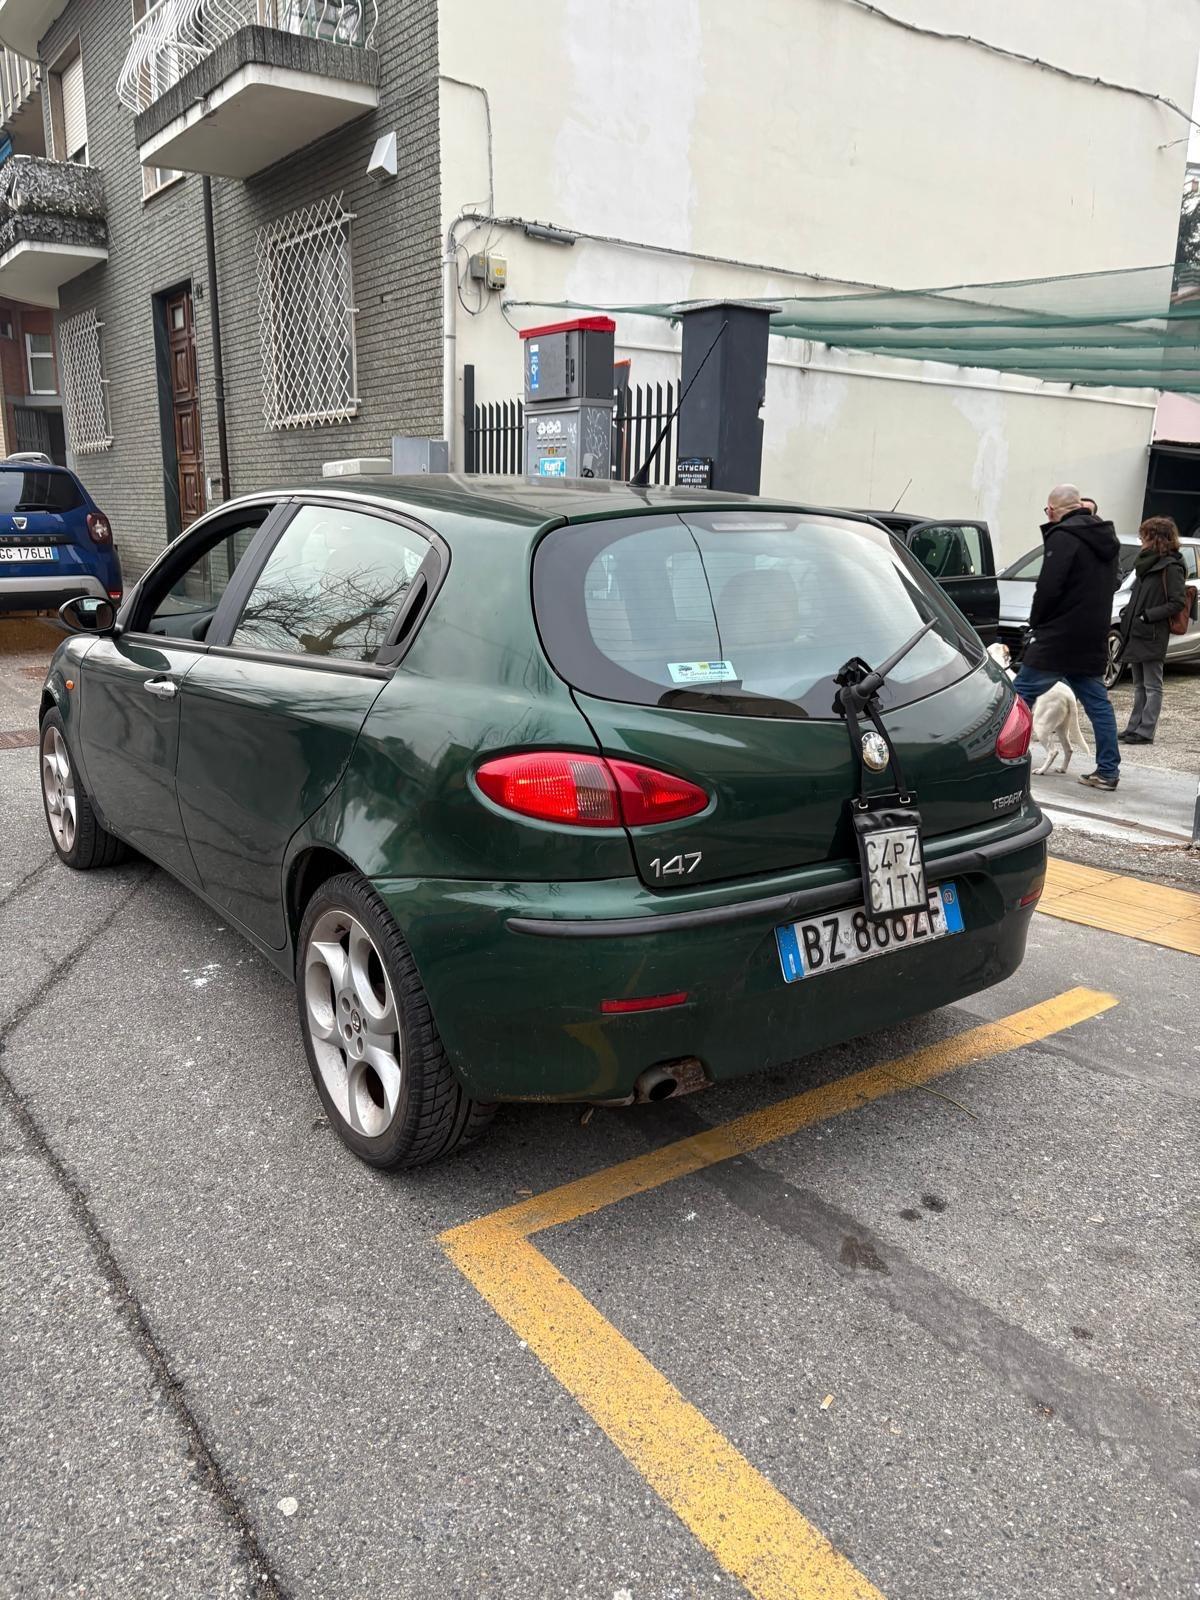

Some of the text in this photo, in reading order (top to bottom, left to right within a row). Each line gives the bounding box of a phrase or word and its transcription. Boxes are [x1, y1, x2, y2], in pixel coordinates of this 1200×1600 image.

[18, 548, 52, 559] 176LH
[649, 851, 702, 878] 147
[801, 917, 846, 970] BZ
